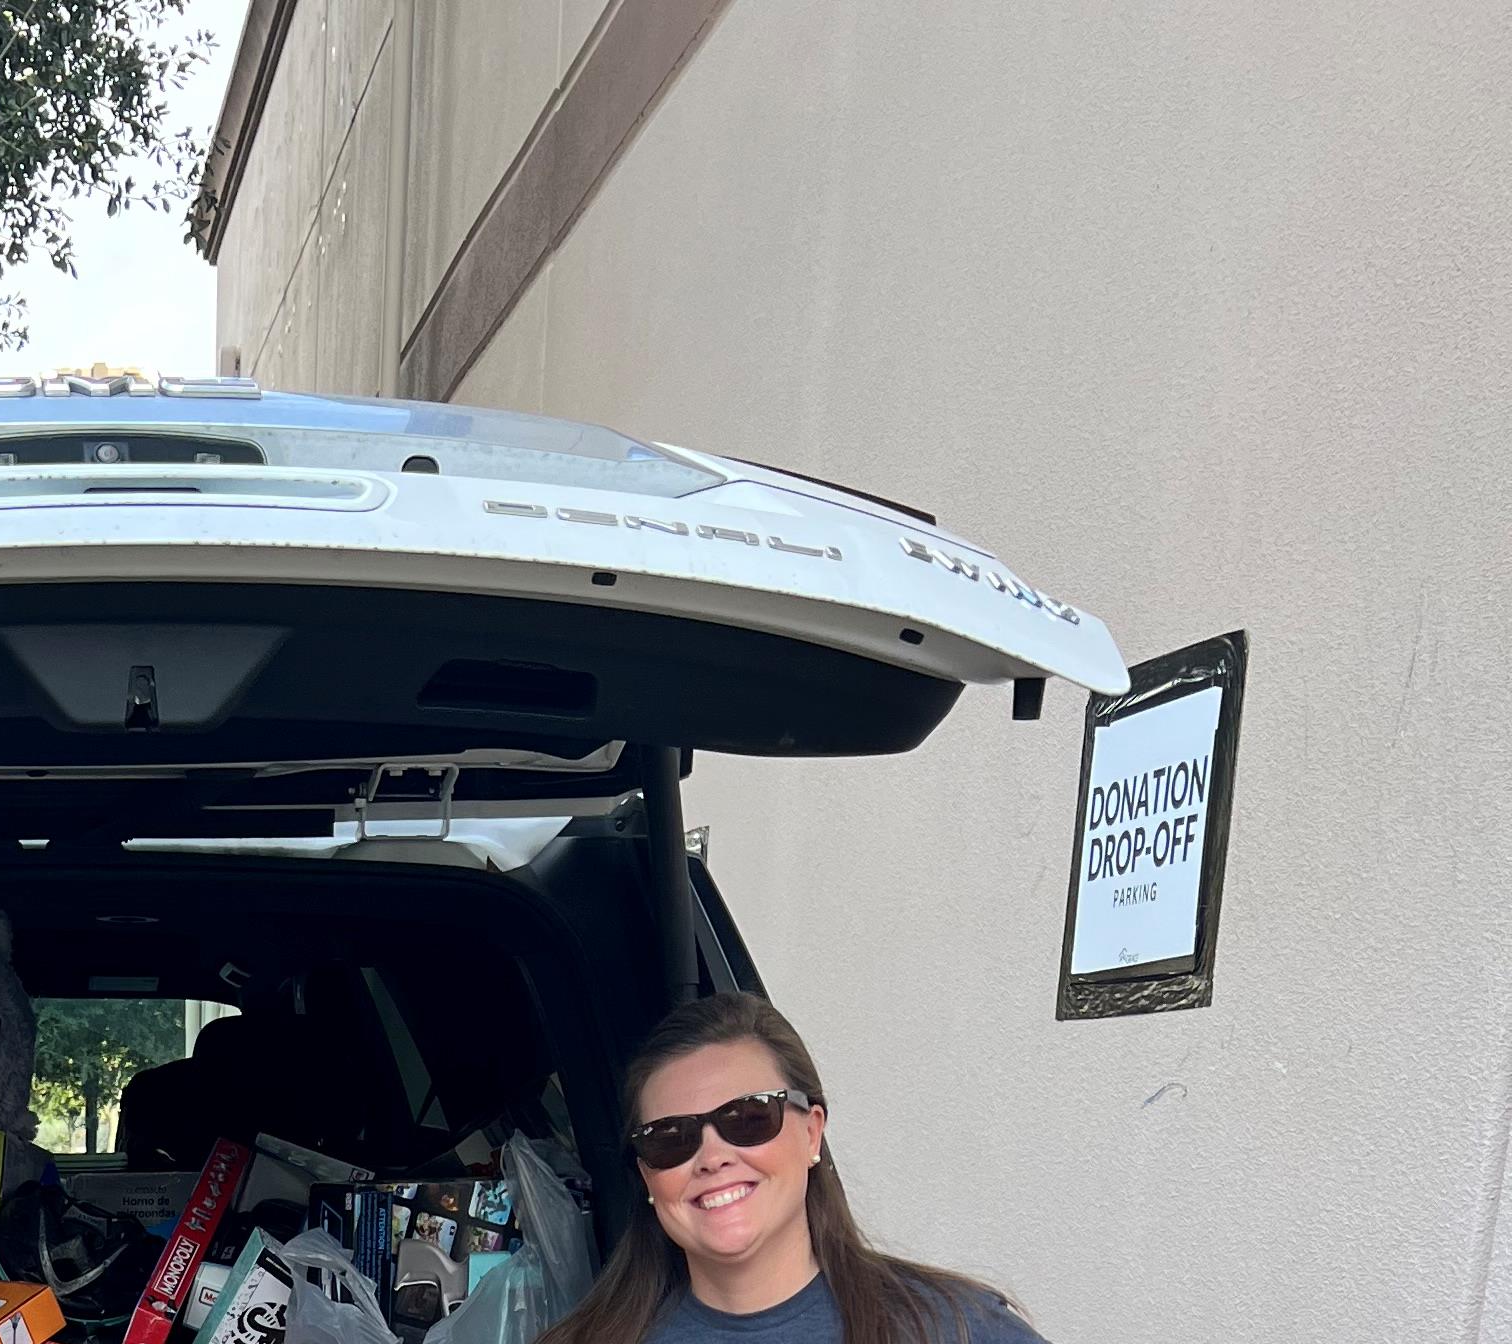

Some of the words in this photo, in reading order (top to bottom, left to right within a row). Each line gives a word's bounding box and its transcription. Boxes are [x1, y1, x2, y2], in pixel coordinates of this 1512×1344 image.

[483, 500, 842, 561] DENALI
[1089, 755, 1209, 832] DONATION
[1088, 813, 1198, 882] DROP-OFF
[1113, 882, 1157, 908] PARKING
[160, 1238, 195, 1295] MONOPOLY
